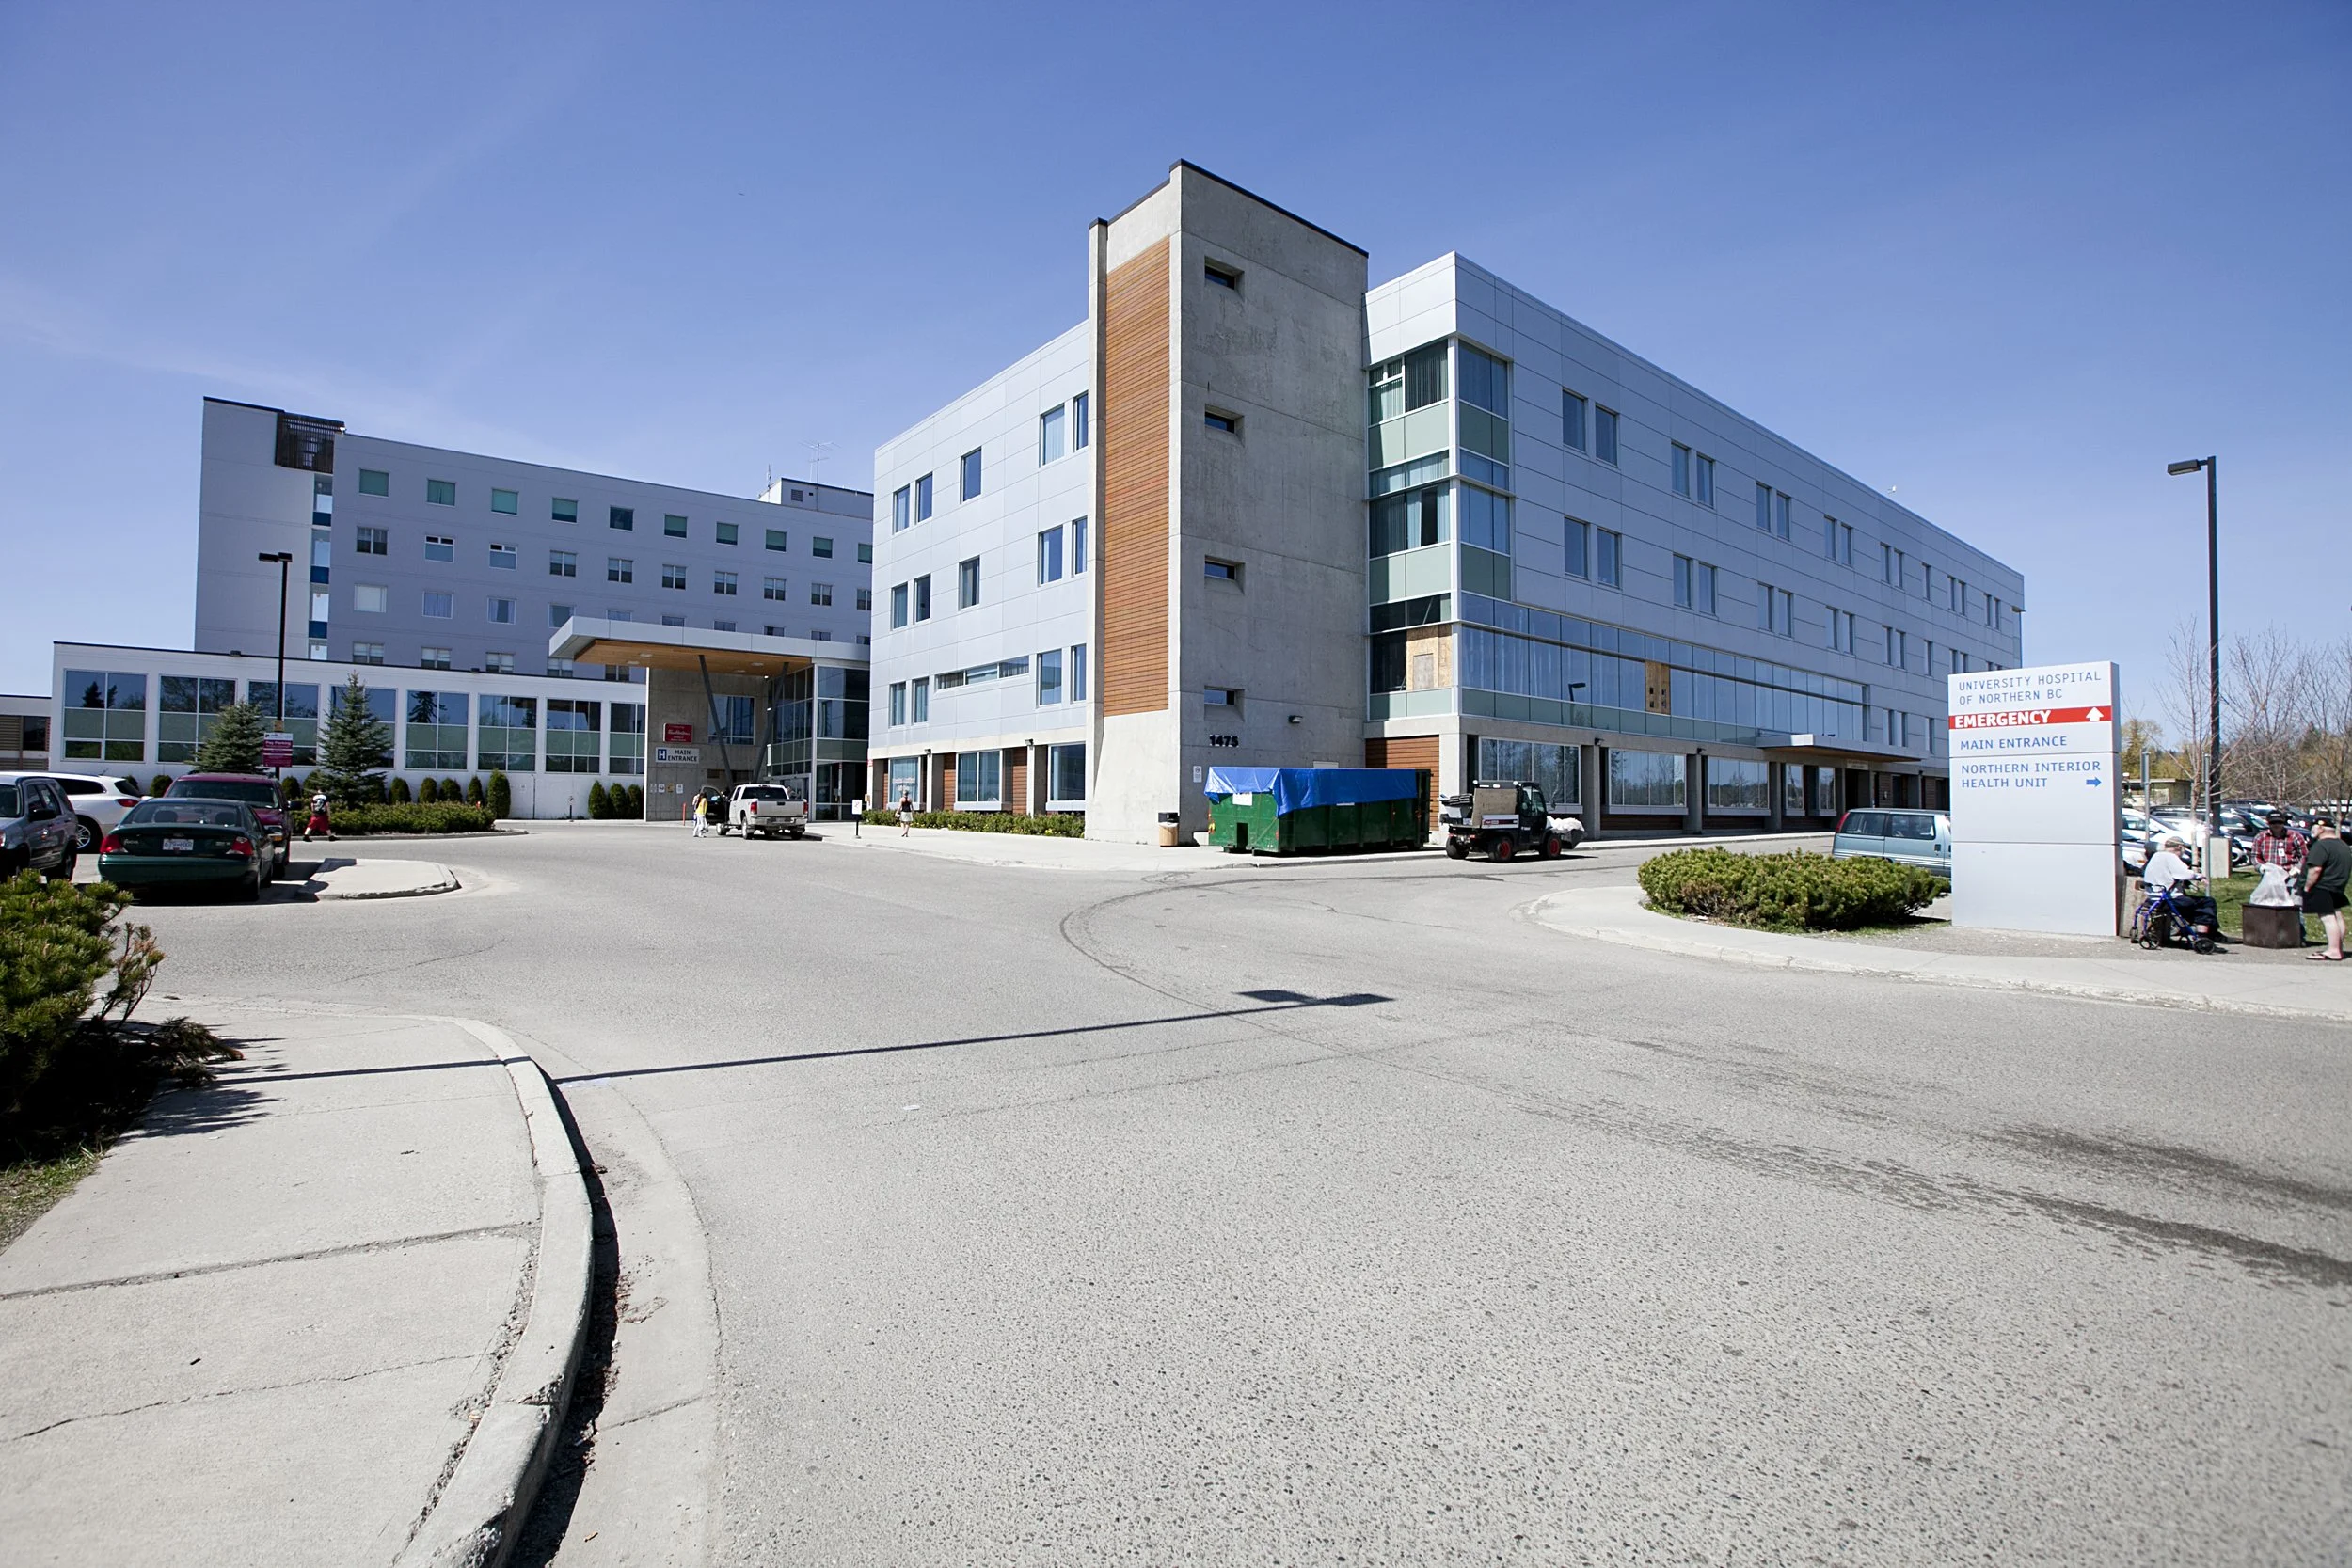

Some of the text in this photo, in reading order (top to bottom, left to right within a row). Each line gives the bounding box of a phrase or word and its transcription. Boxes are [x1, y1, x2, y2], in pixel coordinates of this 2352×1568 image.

[1959, 671, 2101, 691] UNIVERSITY HOSPITAL
[1959, 689, 2062, 705] OF NORTHERN BC
[1955, 710, 2051, 729] EMERGENCY
[1209, 735, 1239, 747] 1475
[1960, 736, 2067, 750] MAIN ENTRANCE
[1962, 761, 2101, 774] NORTHERN INTERIOR
[1962, 778, 2047, 788] HEALTH UNIT
